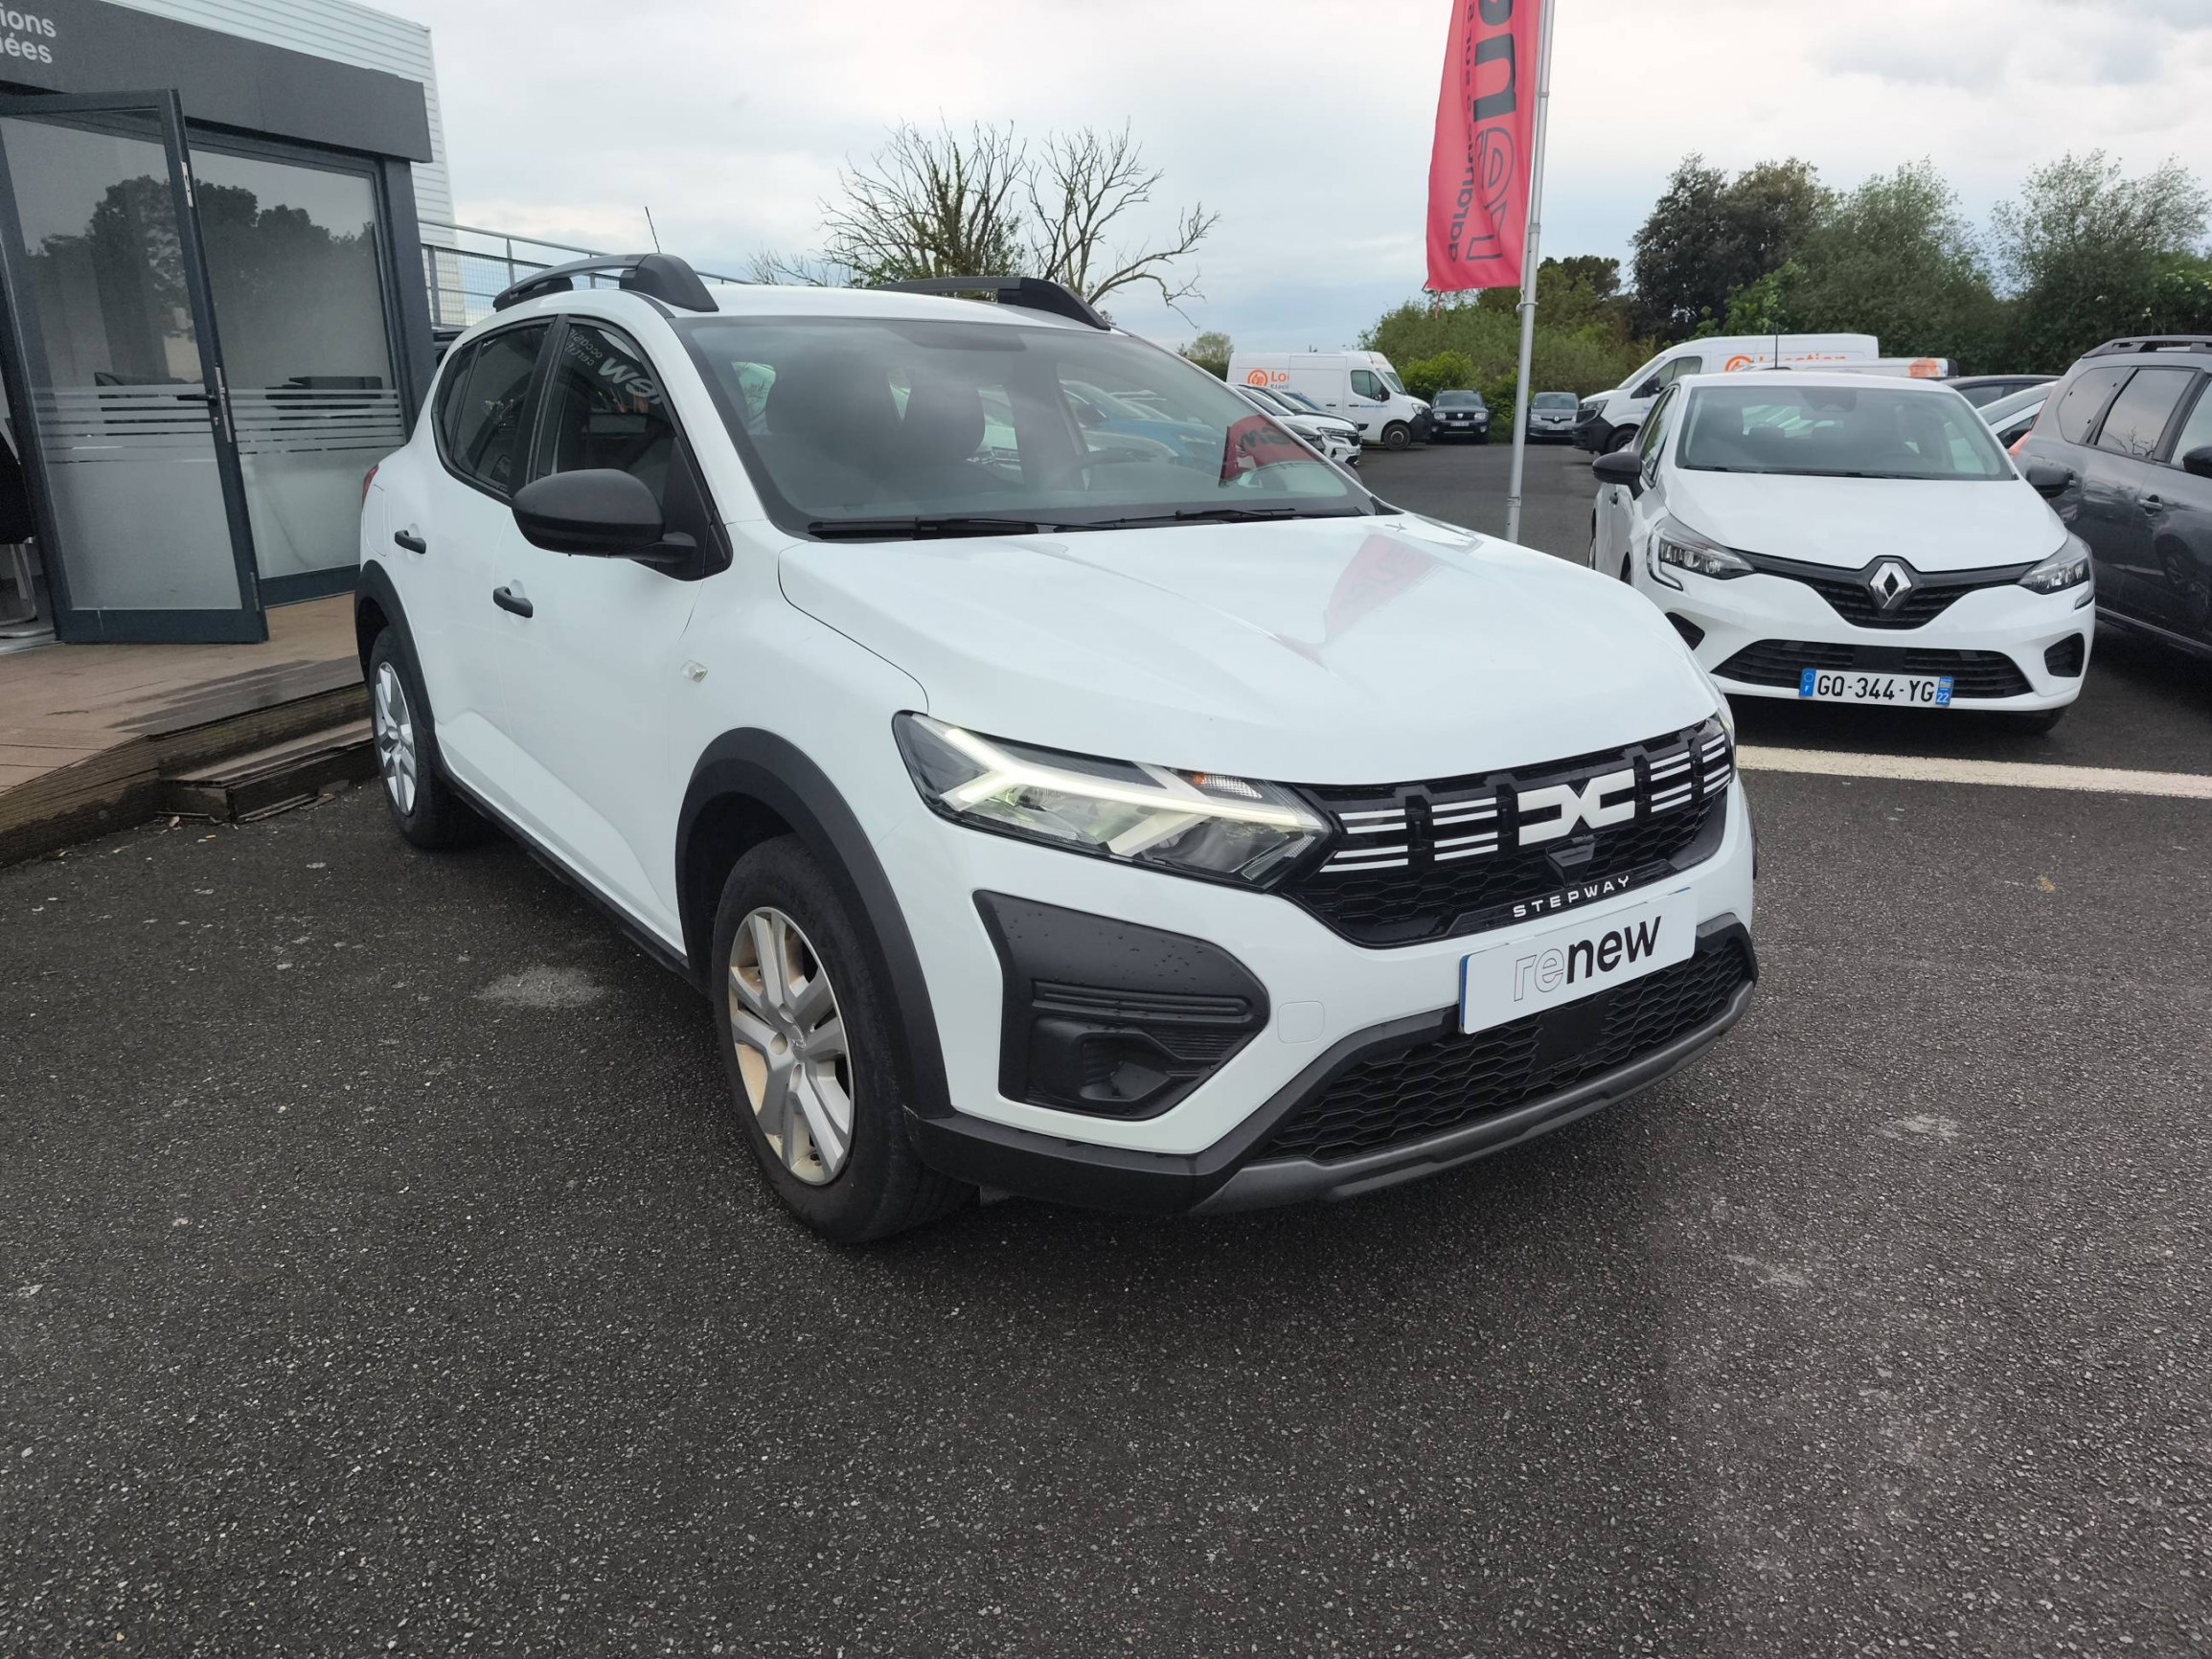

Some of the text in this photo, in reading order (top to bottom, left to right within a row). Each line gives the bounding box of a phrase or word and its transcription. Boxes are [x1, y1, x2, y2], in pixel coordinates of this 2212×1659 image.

[1816, 674, 1935, 702] GQ-344-YG
[1936, 692, 1950, 703] 22
[1513, 875, 1630, 918] STEPWAY
[1514, 916, 1661, 1002] renew
